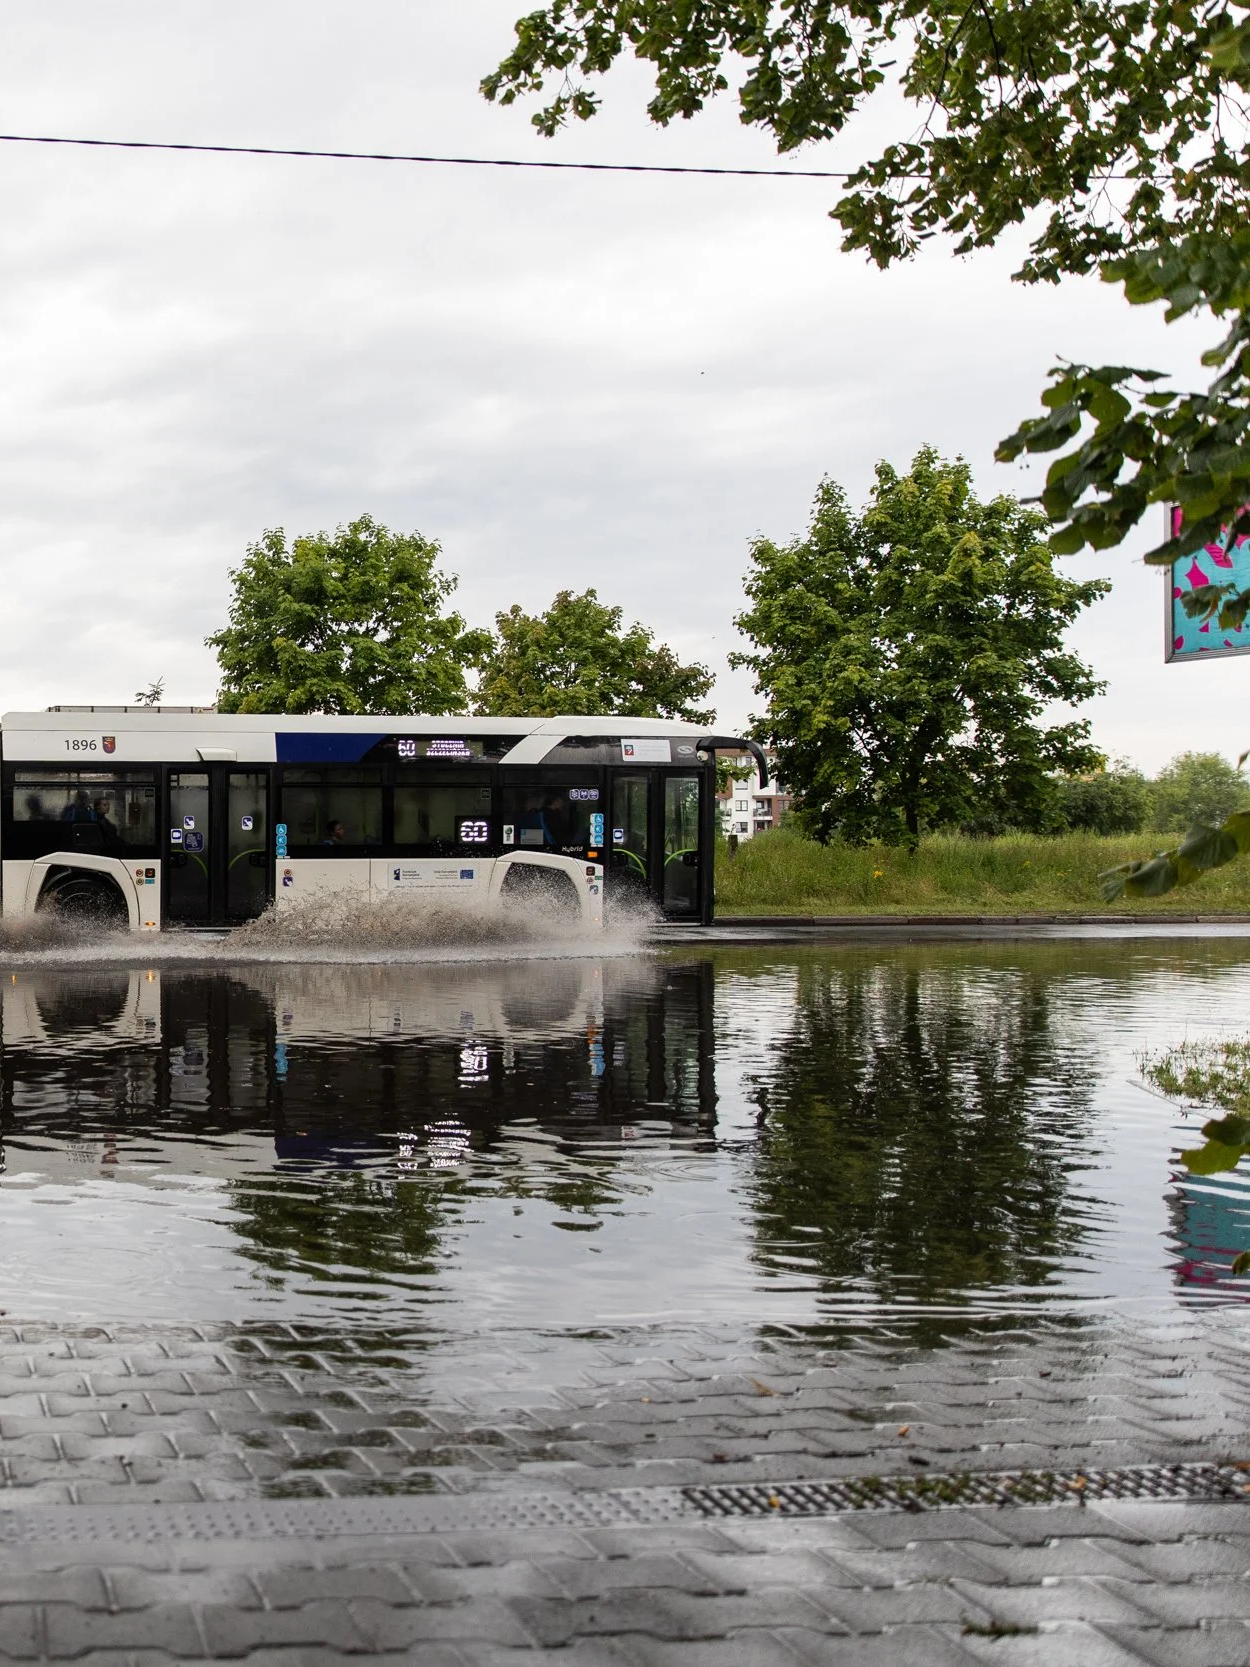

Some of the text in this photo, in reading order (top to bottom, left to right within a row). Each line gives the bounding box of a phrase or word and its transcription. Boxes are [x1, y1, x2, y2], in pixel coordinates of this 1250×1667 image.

[64, 739, 97, 751] 1896
[397, 740, 416, 756] 60
[460, 821, 488, 842] 60
[561, 845, 584, 853] Hybrid
